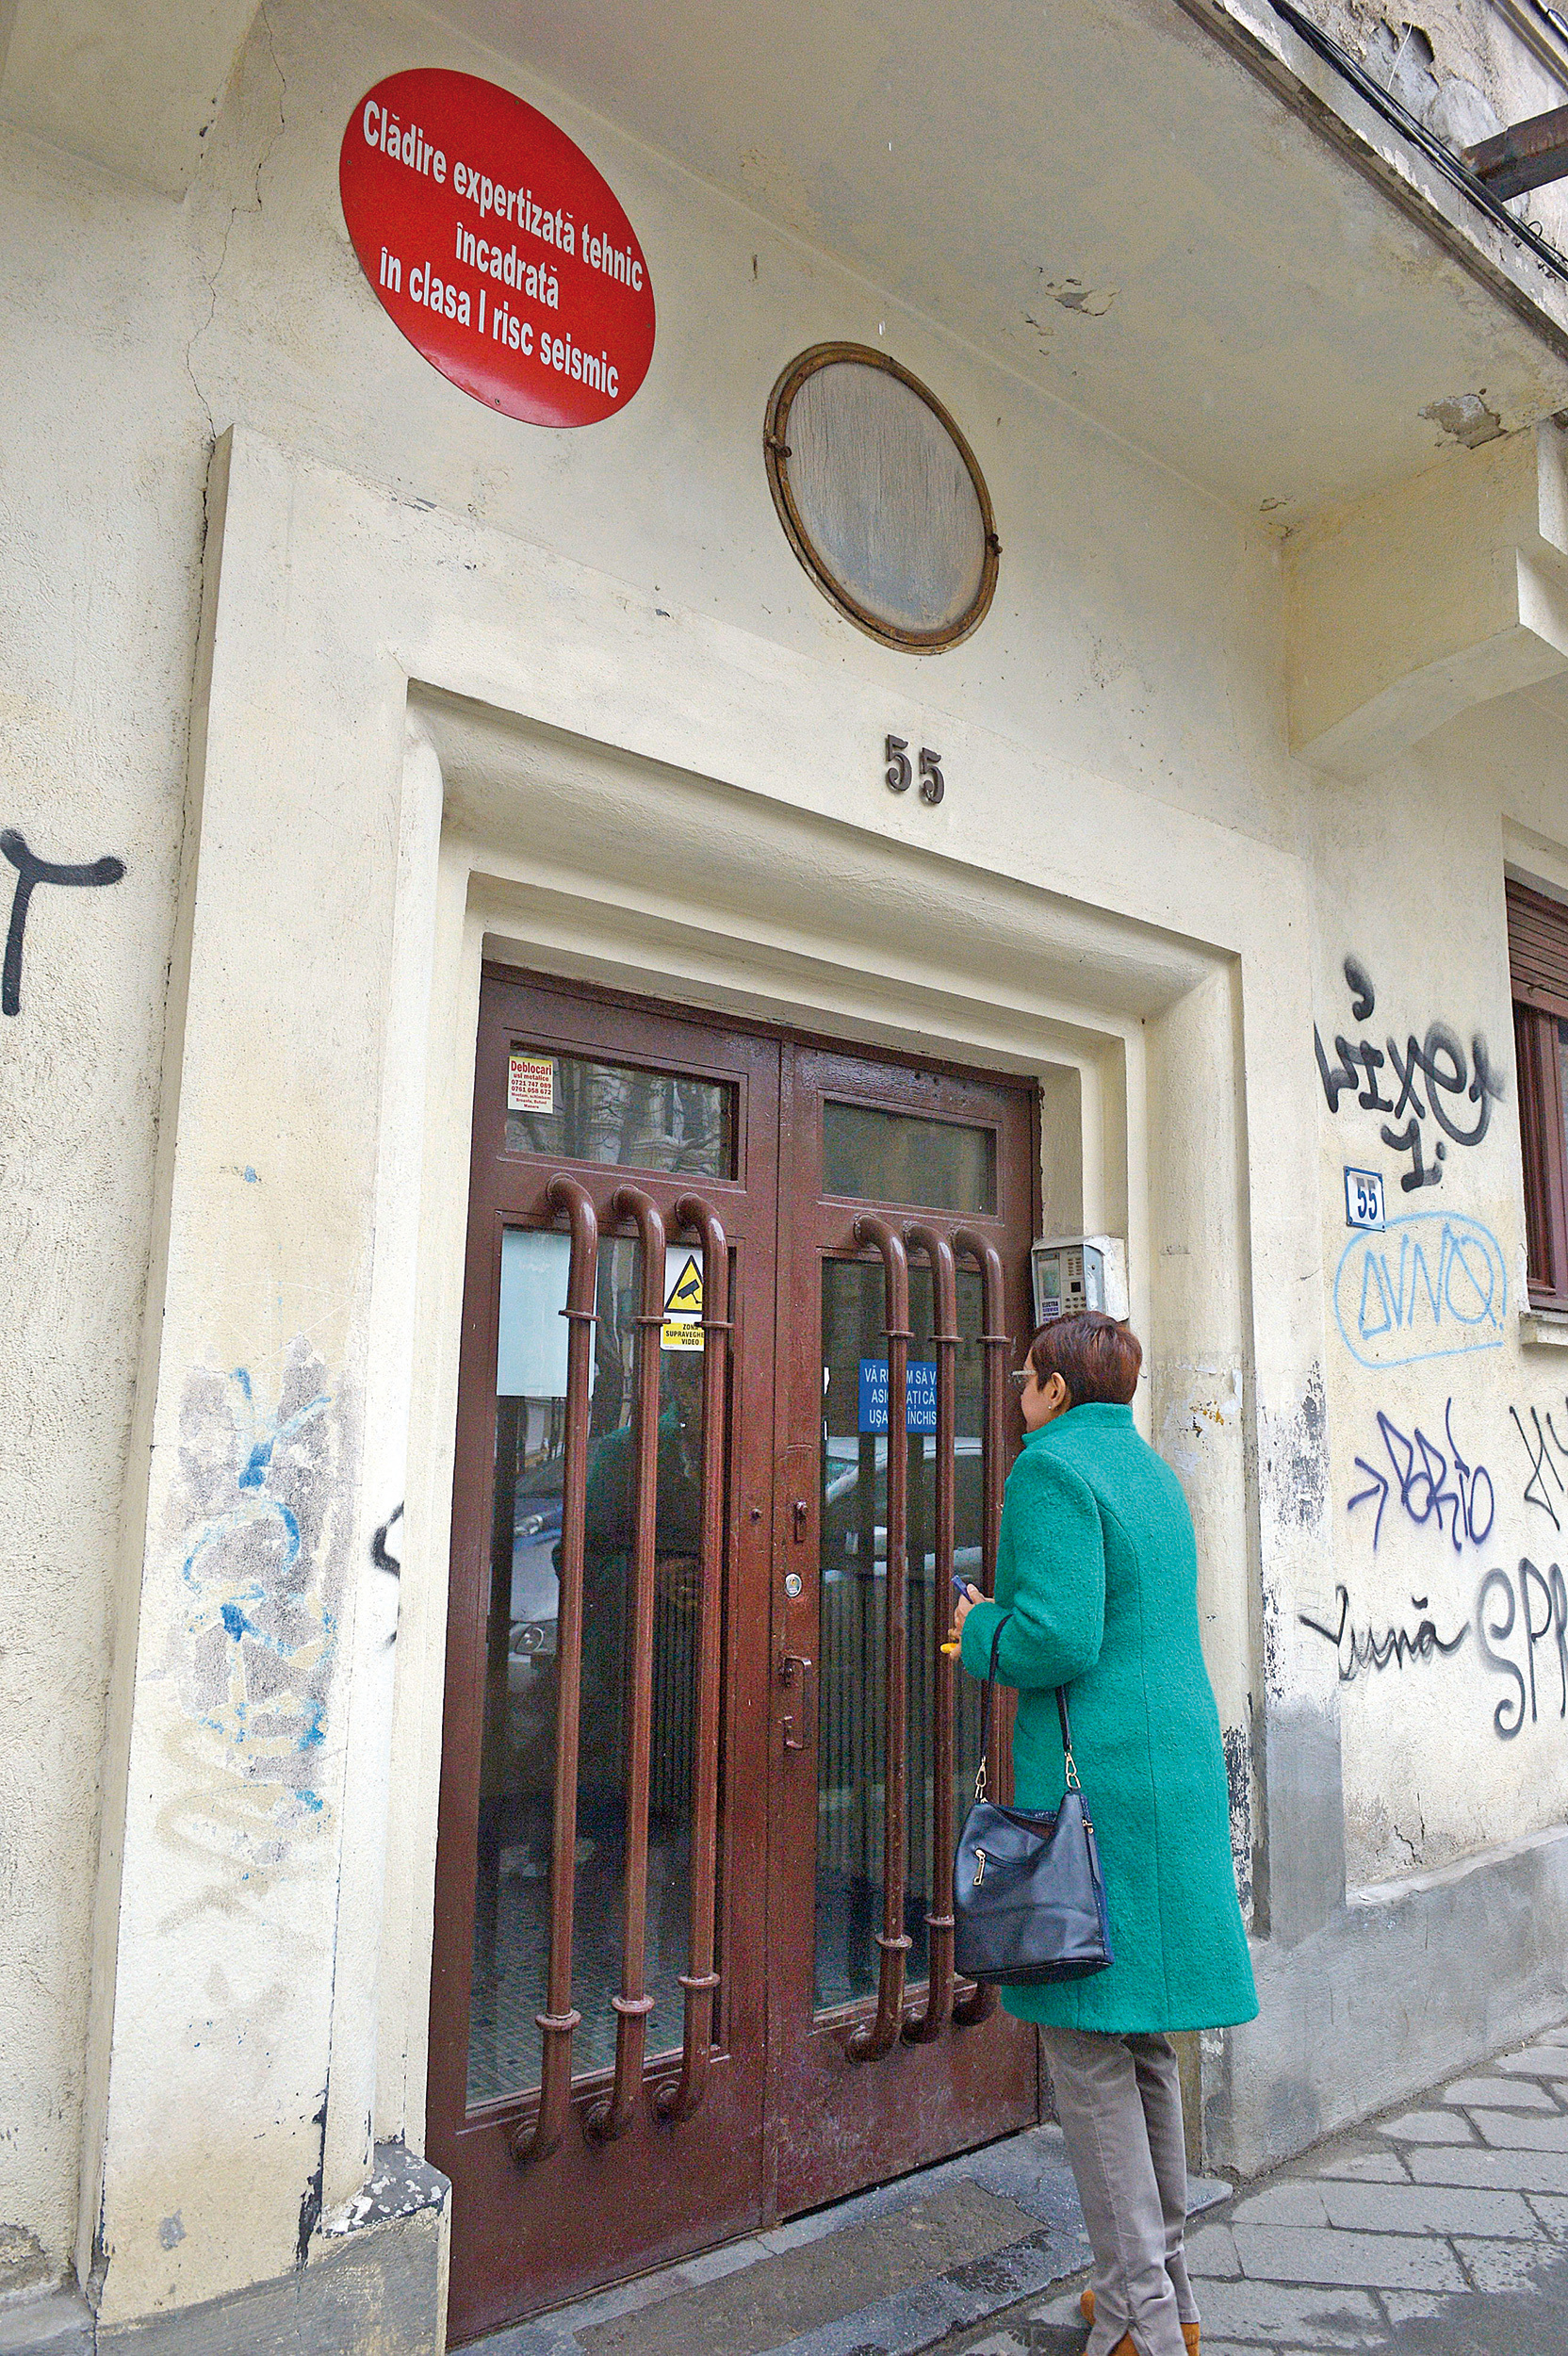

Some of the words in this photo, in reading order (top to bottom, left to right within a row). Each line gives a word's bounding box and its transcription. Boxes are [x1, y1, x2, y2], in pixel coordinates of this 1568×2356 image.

[363, 100, 447, 183] Clădire
[453, 161, 575, 255] expertizată
[581, 223, 643, 291] tehnic
[455, 221, 560, 309] încadrată
[379, 246, 401, 292] în
[409, 262, 471, 326] clasa
[478, 288, 486, 334] I
[492, 301, 533, 356] risc
[540, 333, 619, 398] seismic
[885, 733, 945, 804] 55
[511, 1060, 551, 1075] Deblocari
[1356, 1177, 1378, 1220] 55
[665, 1330, 705, 1338] SUPRAVEGHE
[864, 1365, 877, 1383] VĂ
[915, 1367, 928, 1384] SĂ
[923, 1387, 936, 1405] CĂ
